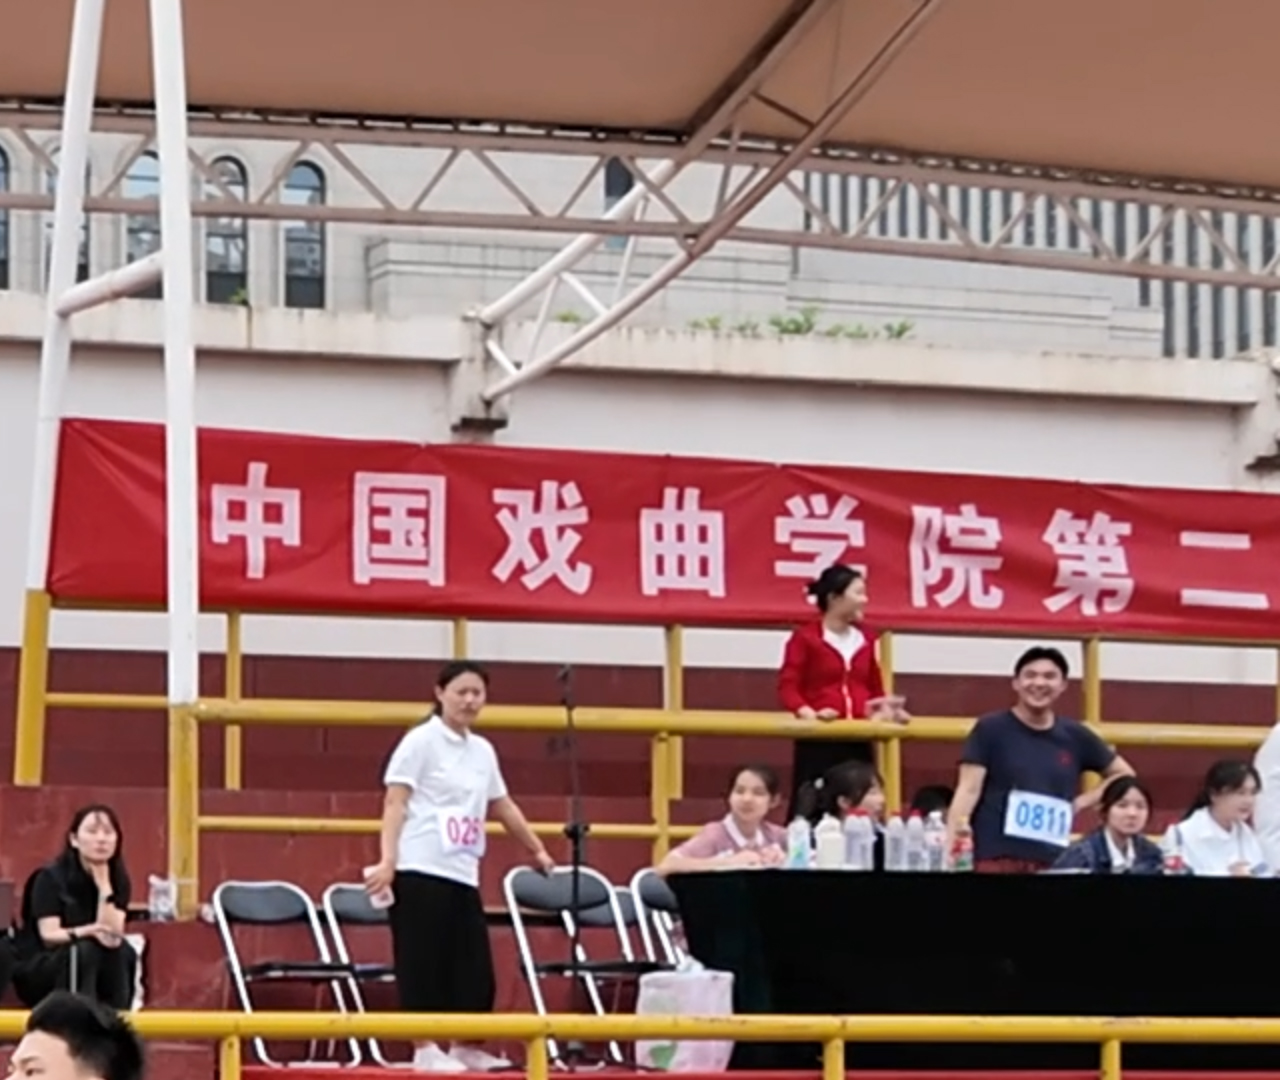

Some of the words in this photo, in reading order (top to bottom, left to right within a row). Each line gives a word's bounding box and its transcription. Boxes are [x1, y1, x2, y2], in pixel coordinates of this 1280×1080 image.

[211, 461, 1270, 616] 中国戏曲学院第二
[1016, 801, 1066, 836] 0811
